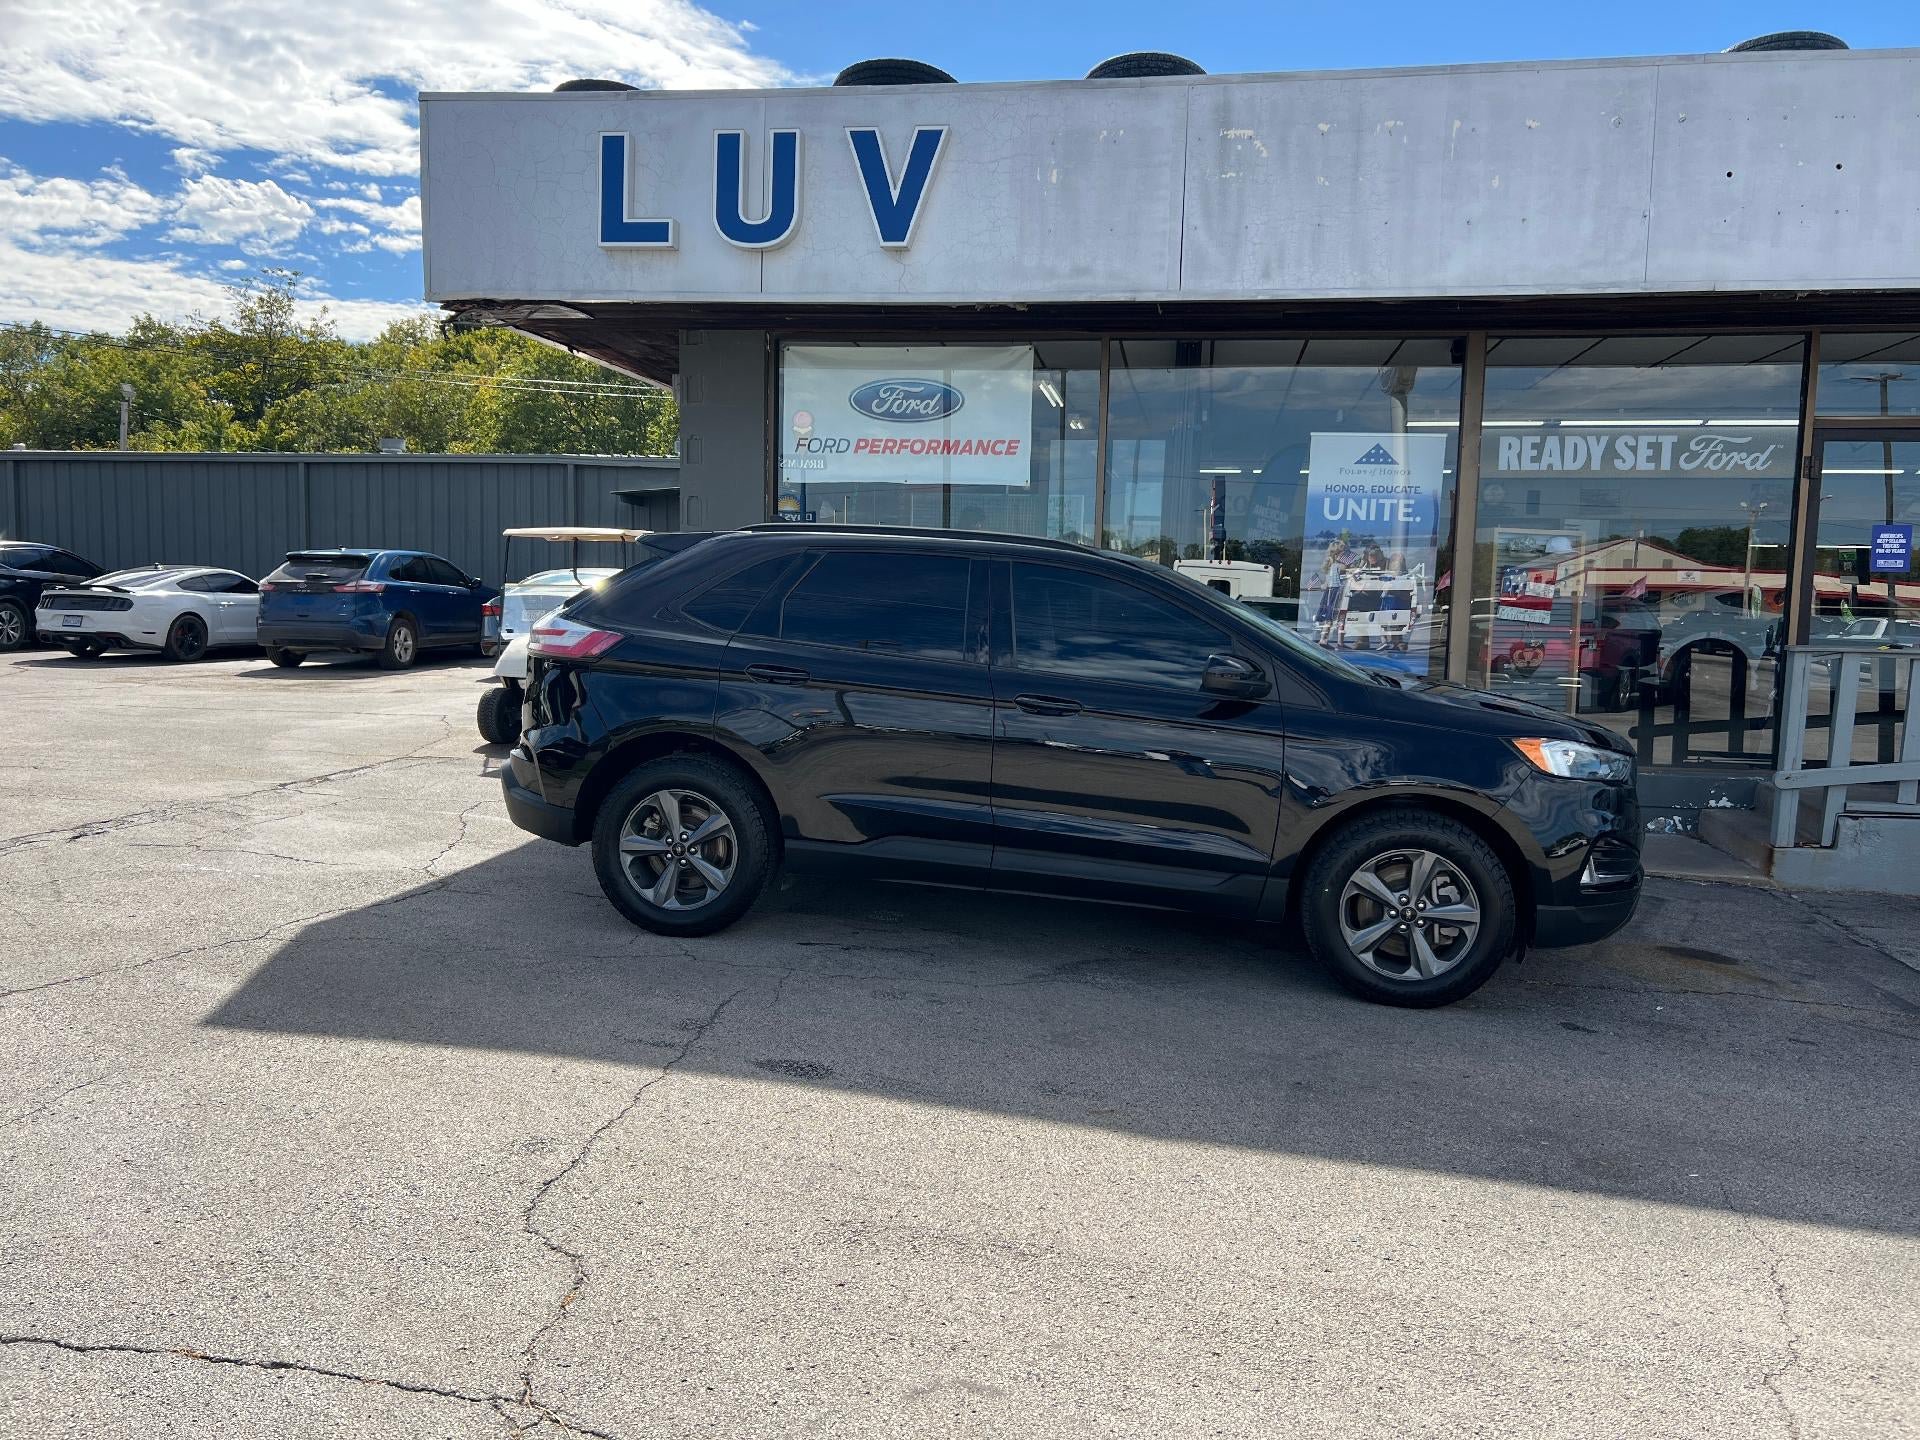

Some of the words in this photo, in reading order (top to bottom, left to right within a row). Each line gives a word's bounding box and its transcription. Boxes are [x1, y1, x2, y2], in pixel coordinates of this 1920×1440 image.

[871, 385, 940, 415] Ford
[794, 437, 850, 454] FORD
[853, 438, 1020, 456] PERFORMANCE
[1498, 435, 1609, 471] READY
[1613, 434, 1678, 471] SET
[1678, 434, 1777, 472] Ford
[1325, 484, 1368, 494] HONOR.
[1371, 485, 1422, 495] EDUCATE.
[1323, 497, 1422, 523] UNITE.
